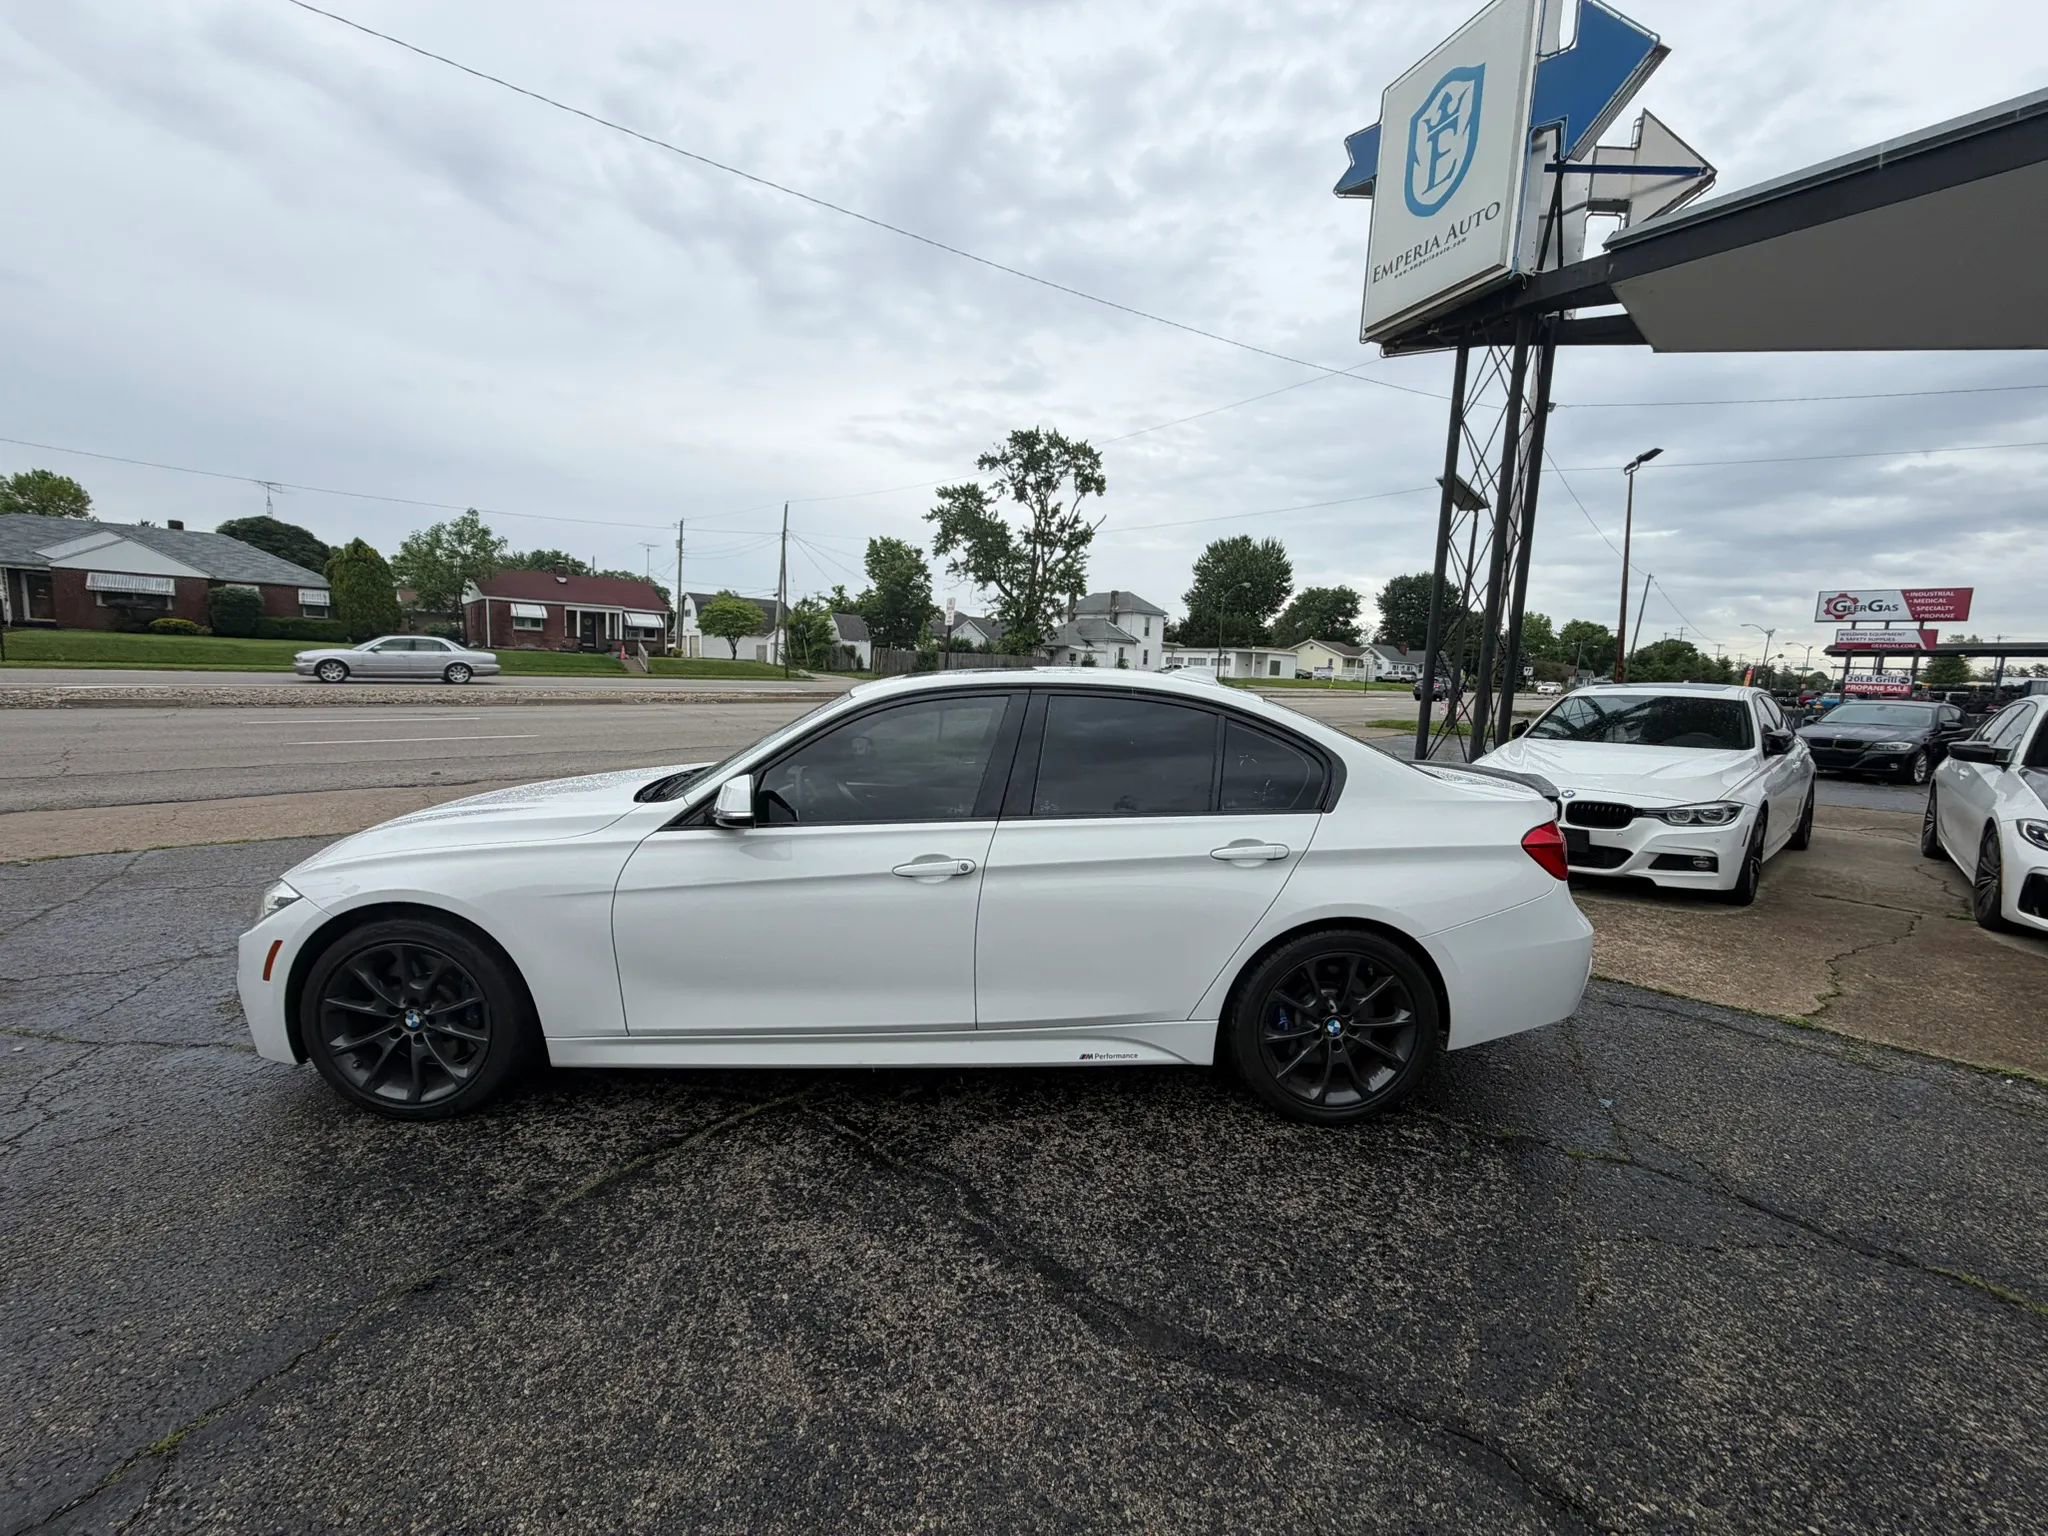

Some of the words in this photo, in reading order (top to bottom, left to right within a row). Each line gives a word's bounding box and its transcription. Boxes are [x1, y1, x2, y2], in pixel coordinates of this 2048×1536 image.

[1373, 234, 1440, 284] EMPERIA
[1443, 201, 1501, 245] AUTO
[1875, 675, 1897, 684] Grill
